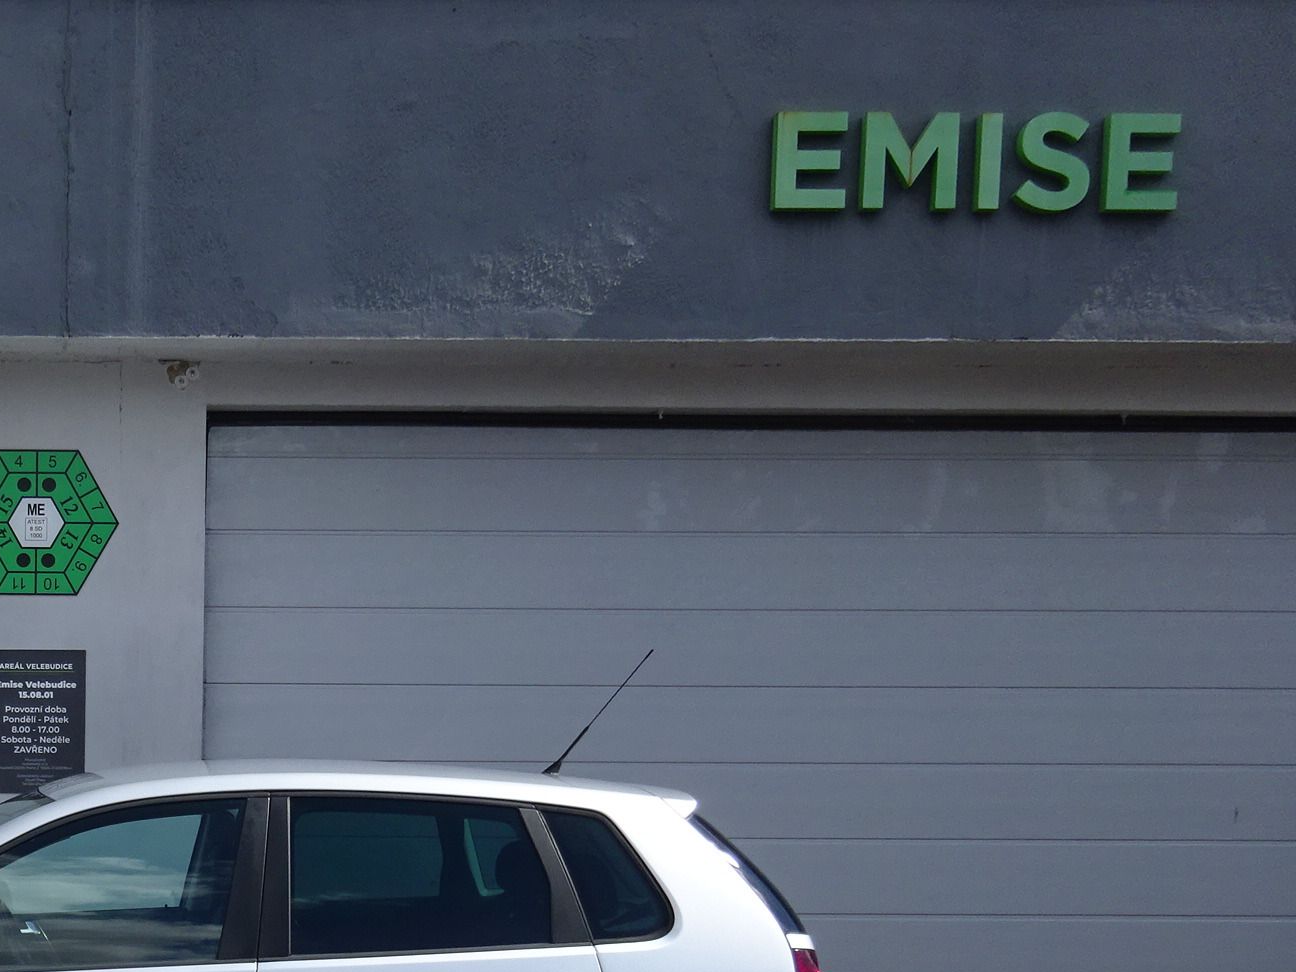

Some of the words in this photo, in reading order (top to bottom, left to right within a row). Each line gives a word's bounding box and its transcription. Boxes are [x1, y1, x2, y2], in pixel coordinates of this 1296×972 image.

[770, 110, 1182, 214] EMISE
[14, 455, 24, 468] 4
[48, 455, 57, 468] 5
[27, 503, 46, 516] ME
[60, 495, 79, 516] 12
[91, 502, 105, 511] 7
[60, 529, 79, 550] 13
[90, 534, 103, 545] 8
[12, 577, 26, 590] 11
[43, 577, 59, 591] 10
[0, 661, 24, 670] AREÁL
[25, 680, 77, 689] Velebudice
[18, 691, 54, 699] 15.08.01
[5, 705, 43, 713] Provozní
[44, 705, 67, 713] doba
[2, 715, 37, 724] Pondělí
[43, 715, 70, 724] Pátek
[11, 725, 31, 734] 8.00
[37, 725, 60, 734] 17.00
[0, 735, 32, 744] Sobota
[39, 736, 71, 744] Neděle
[13, 744, 58, 754] ZAVŘENO
